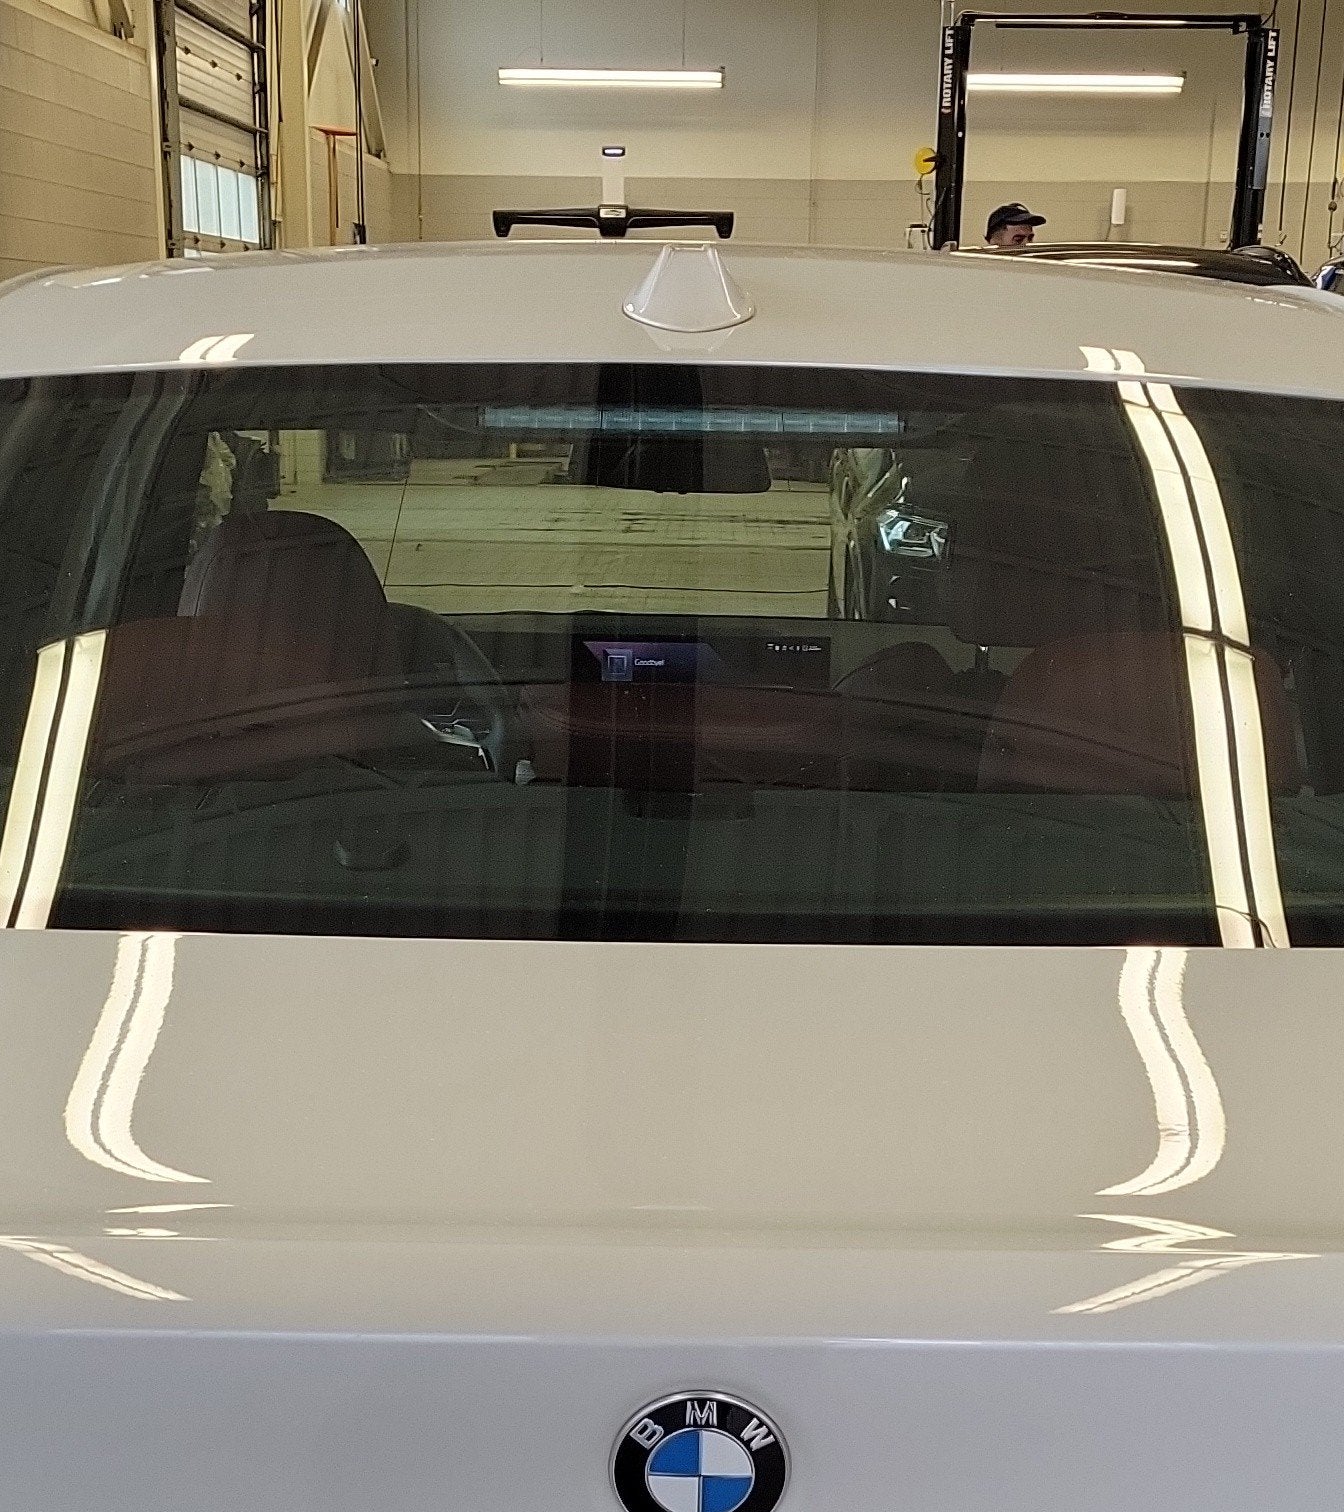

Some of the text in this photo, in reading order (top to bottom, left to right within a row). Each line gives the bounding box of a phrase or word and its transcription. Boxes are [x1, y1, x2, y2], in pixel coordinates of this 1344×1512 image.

[945, 27, 955, 54] LIFT
[1267, 30, 1277, 57] LIFT
[629, 1400, 775, 1452] BMW
